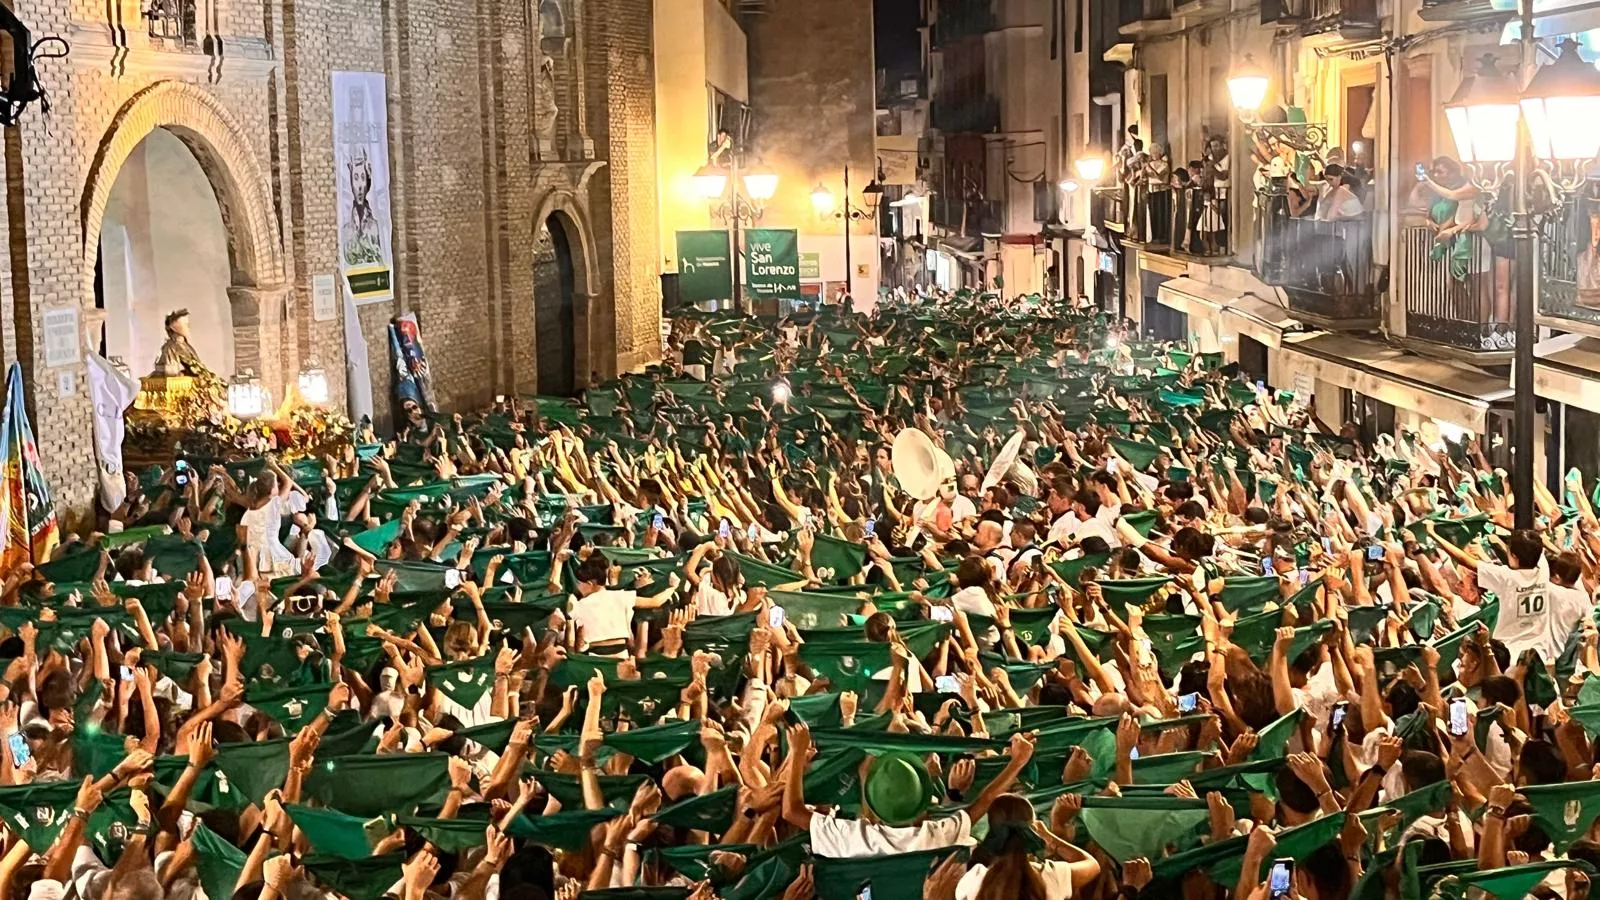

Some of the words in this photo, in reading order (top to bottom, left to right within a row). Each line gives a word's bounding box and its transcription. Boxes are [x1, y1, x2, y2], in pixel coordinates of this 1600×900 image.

[750, 242, 771, 252] vive
[750, 251, 773, 264] San
[751, 263, 795, 276] Lorenzo
[1520, 595, 1544, 614] 10
